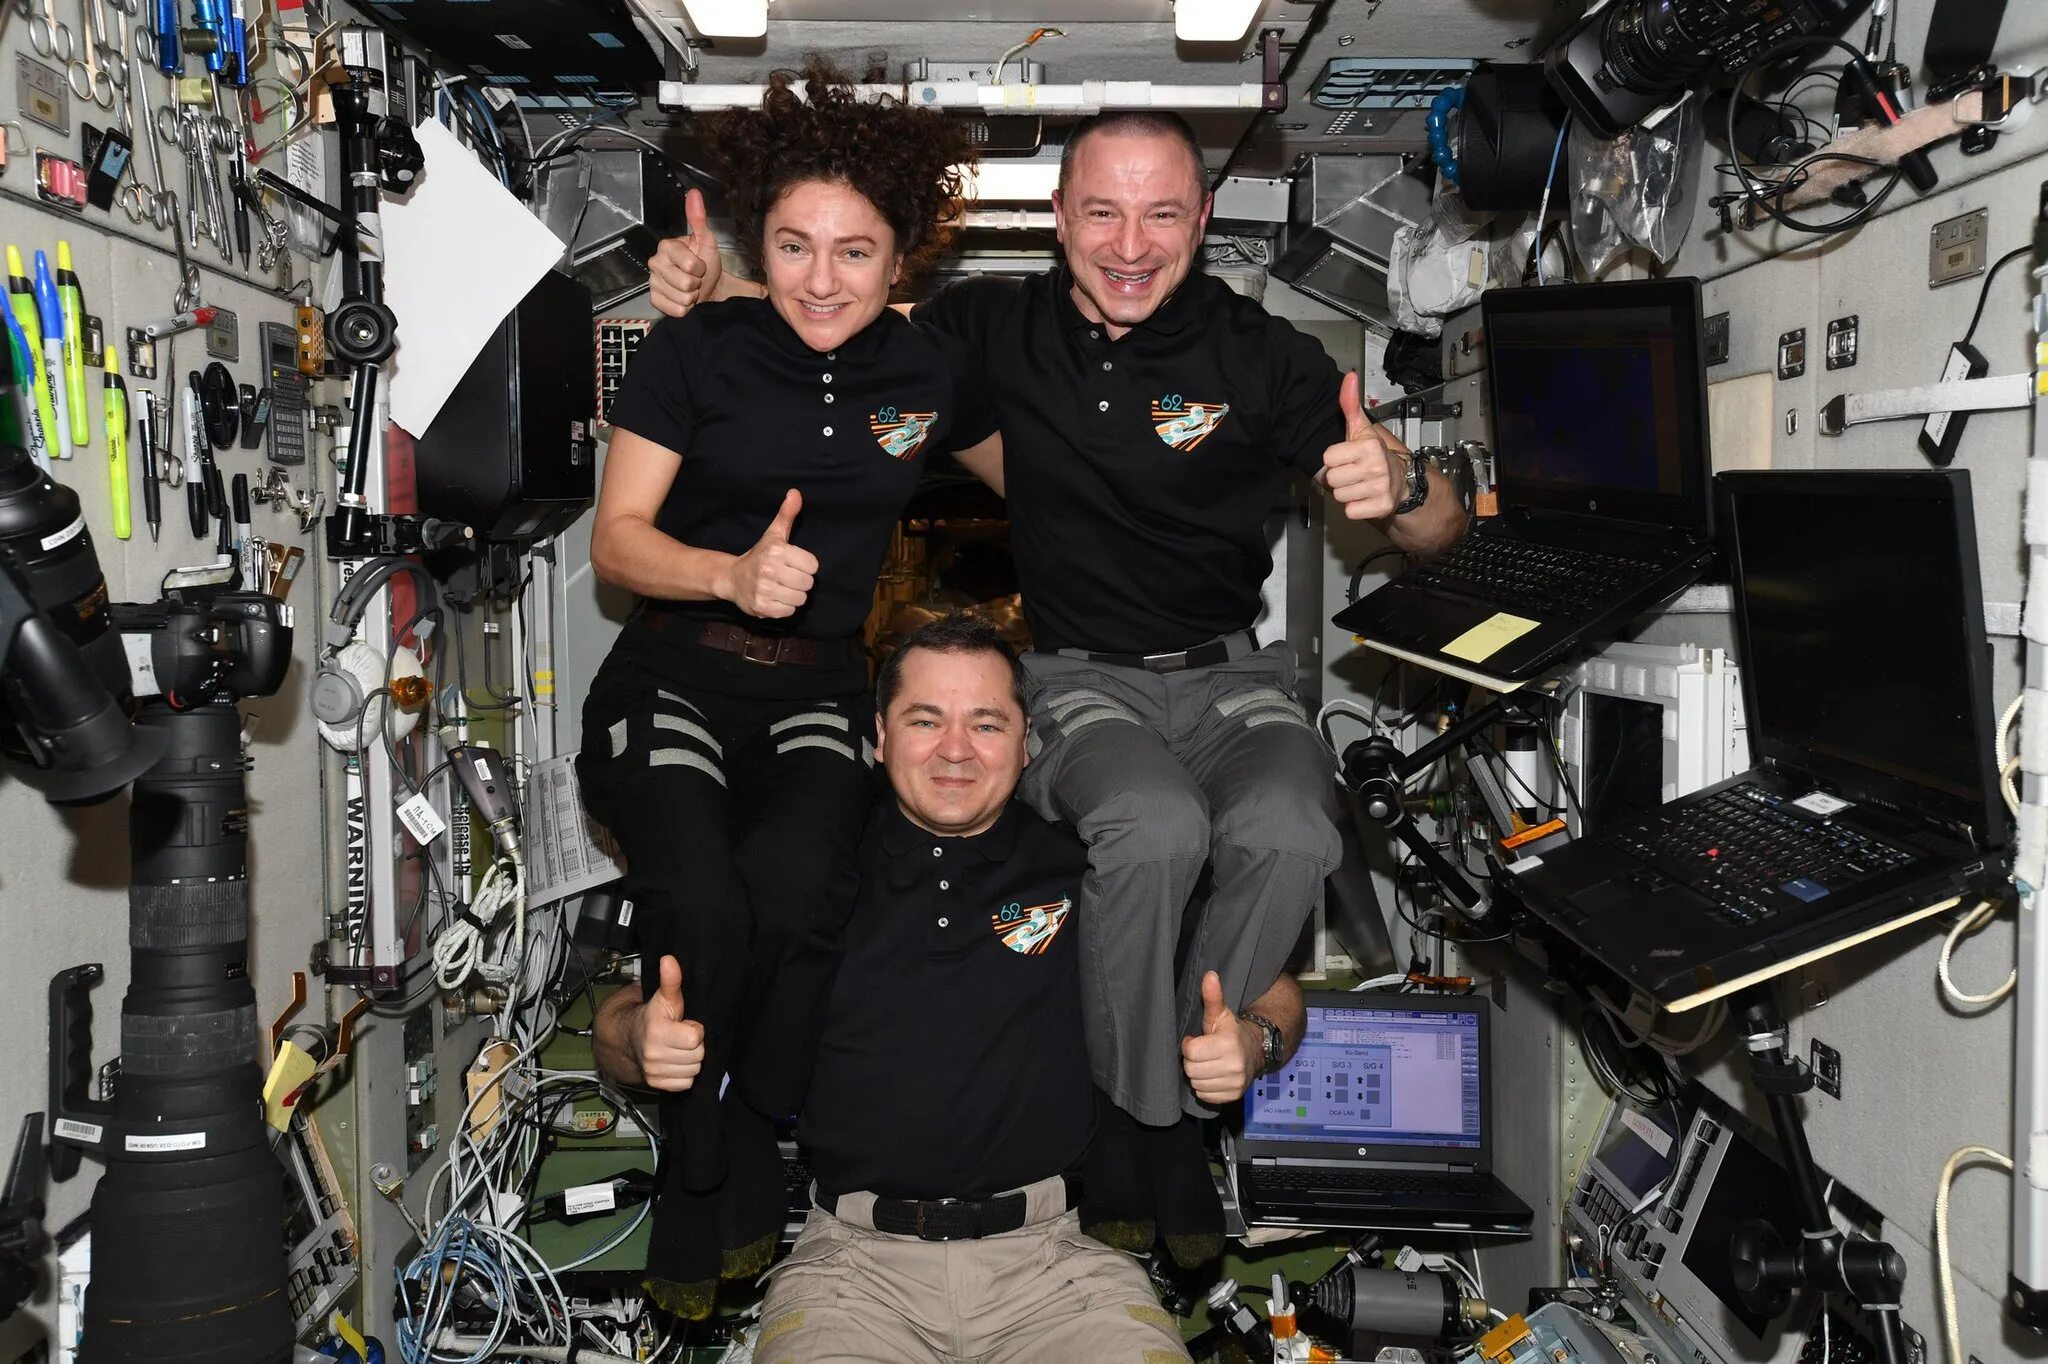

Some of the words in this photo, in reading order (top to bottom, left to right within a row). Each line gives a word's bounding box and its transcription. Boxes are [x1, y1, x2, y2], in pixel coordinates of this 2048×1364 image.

[1161, 394, 1183, 411] 62
[878, 406, 898, 423] 62
[459, 807, 470, 855] Release
[347, 796, 367, 944] WARNING
[1000, 903, 1023, 921] 62
[1295, 1060, 1309, 1068] S/G
[1310, 1060, 1315, 1068] 2
[1332, 1061, 1345, 1069] S/G
[1363, 1062, 1377, 1070] S/G
